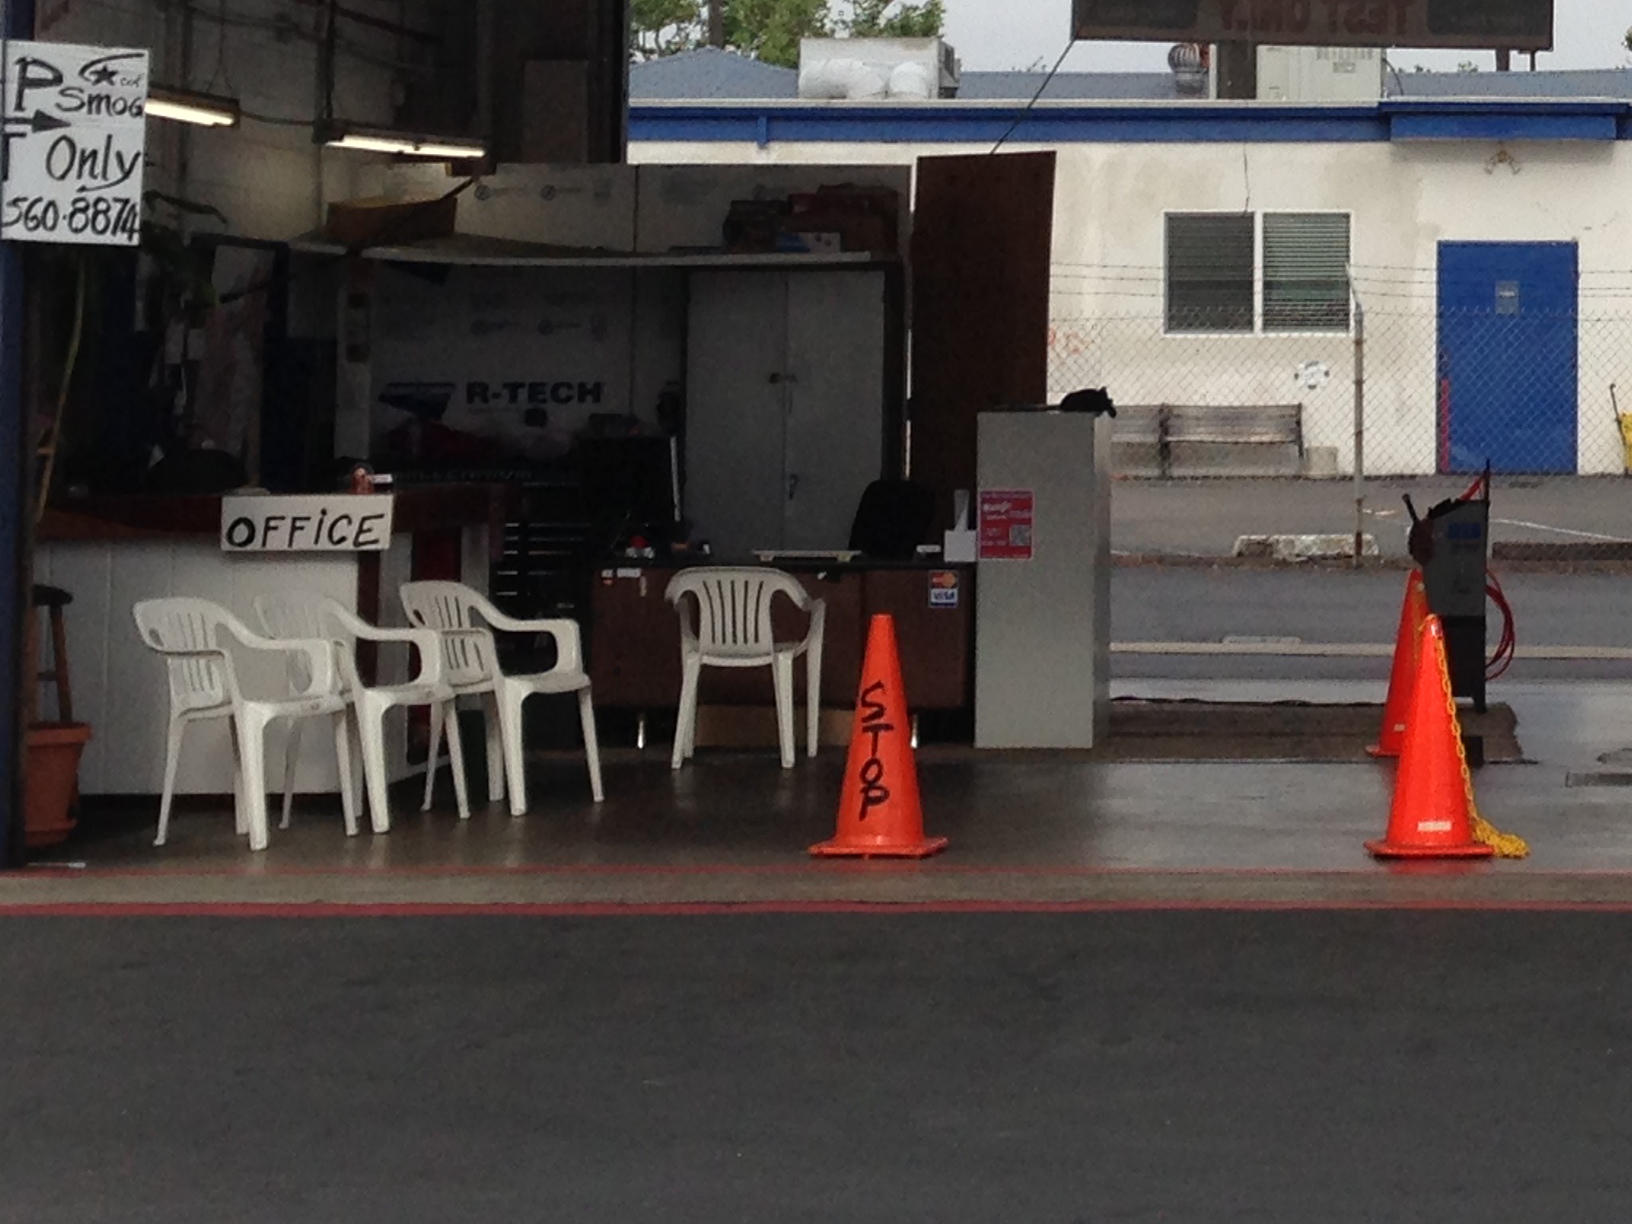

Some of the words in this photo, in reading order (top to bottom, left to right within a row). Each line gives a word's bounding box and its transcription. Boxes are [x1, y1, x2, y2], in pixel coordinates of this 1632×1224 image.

[15, 57, 64, 111] P
[45, 133, 141, 193] Only
[466, 382, 606, 404] R-TECH
[859, 680, 895, 821] STOP
